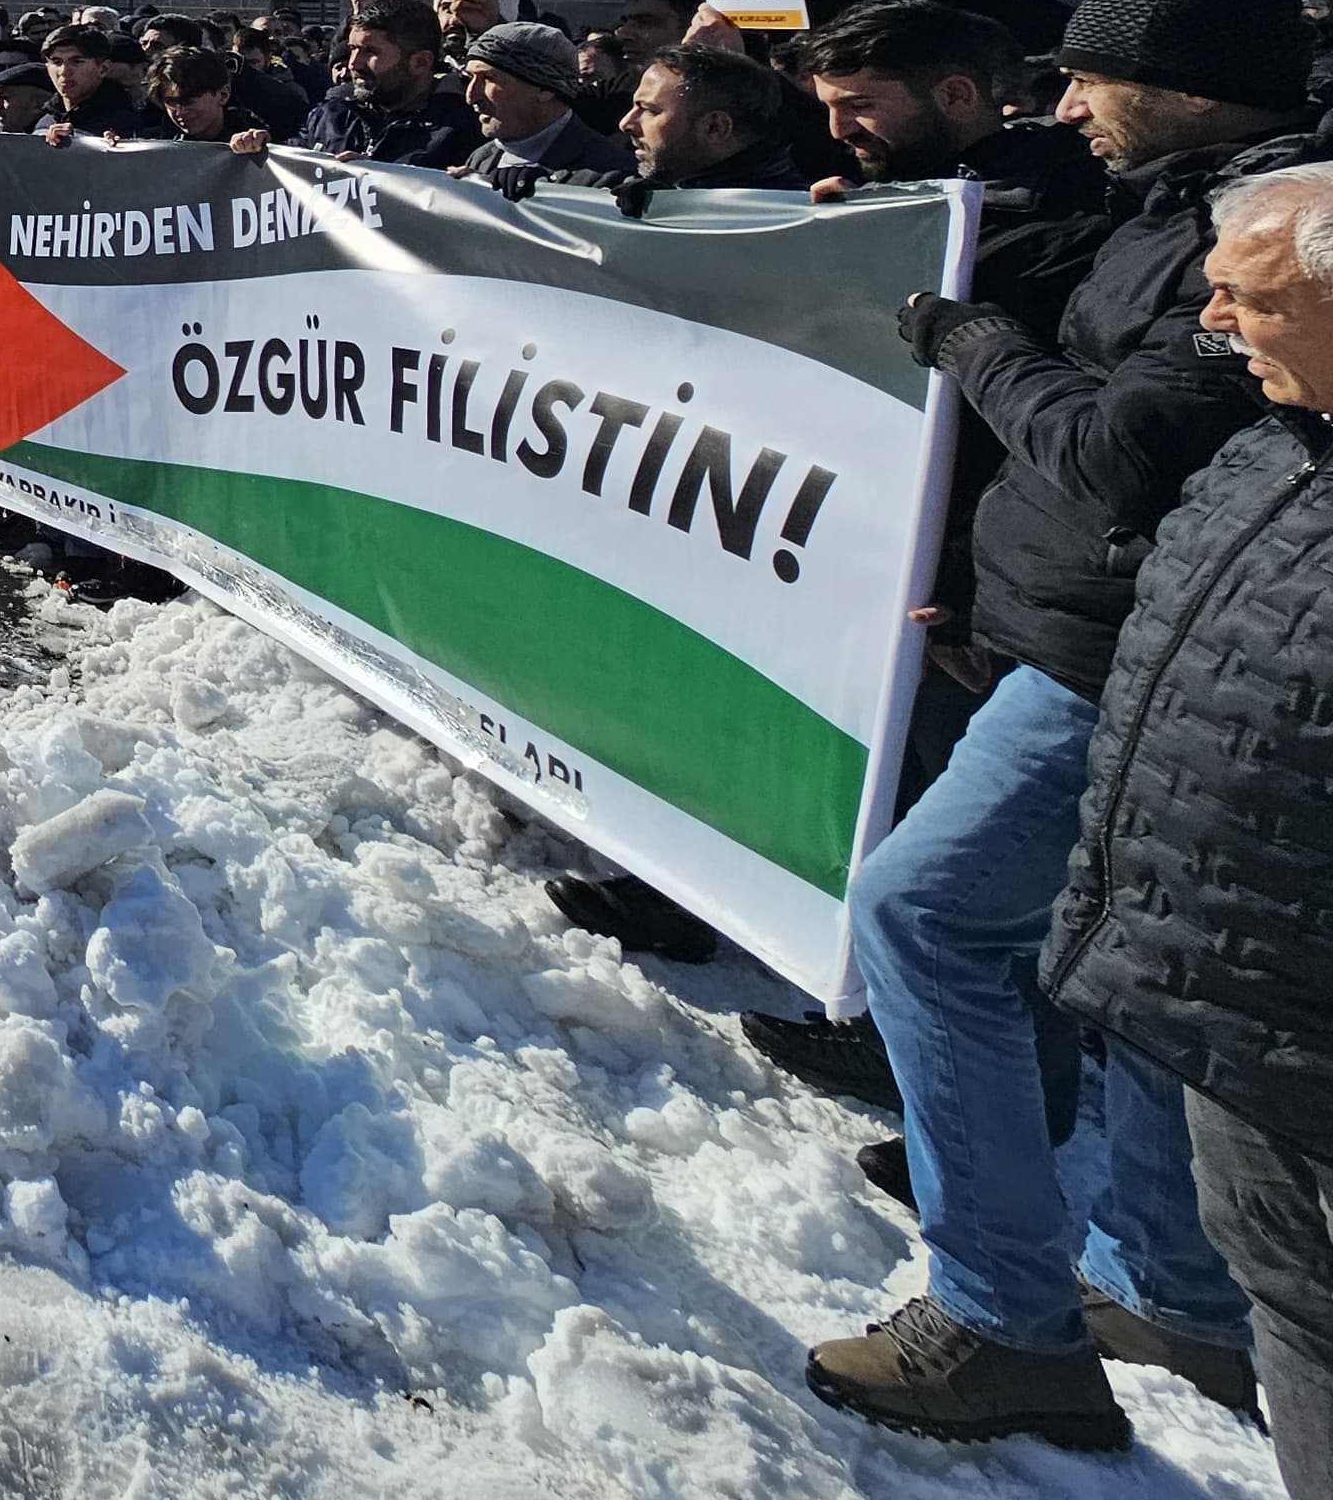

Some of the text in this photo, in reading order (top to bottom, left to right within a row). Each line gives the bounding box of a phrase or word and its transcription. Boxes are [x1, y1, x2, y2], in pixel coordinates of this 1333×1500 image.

[9, 167, 383, 260] NEHİR'DEN DENİZ'E
[172, 314, 839, 584] ÖZGÜR FİLİSTİN!
